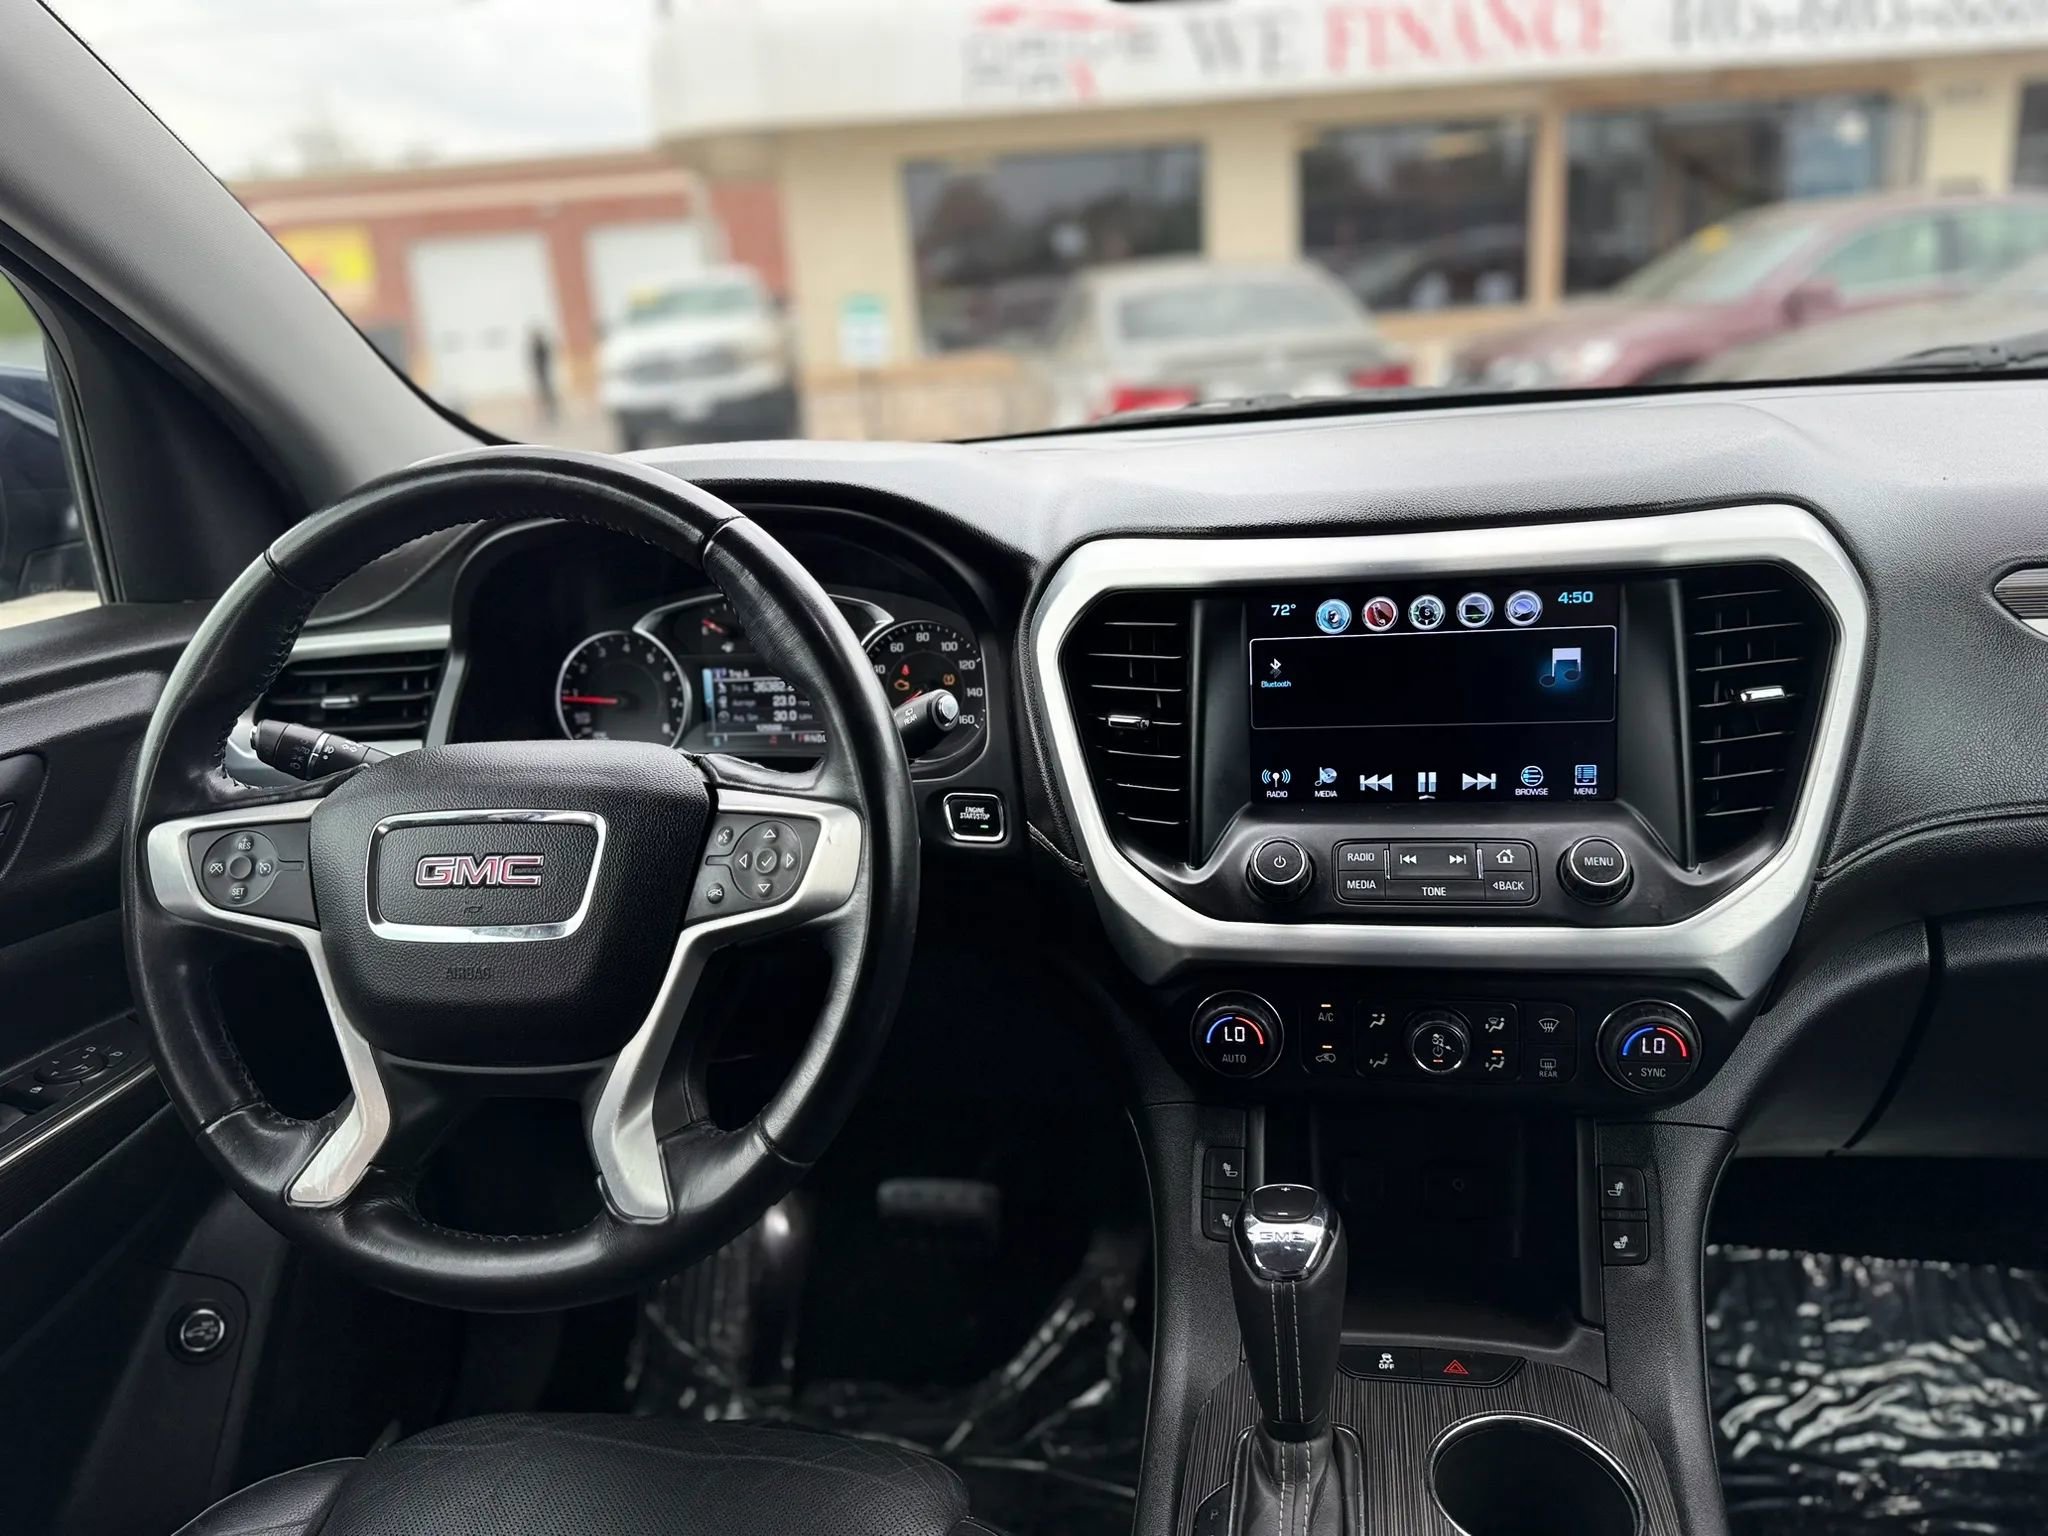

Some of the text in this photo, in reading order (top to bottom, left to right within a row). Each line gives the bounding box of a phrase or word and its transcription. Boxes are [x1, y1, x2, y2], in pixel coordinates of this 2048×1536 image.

[1324, 0, 1616, 72] FINANCE
[1557, 591, 1594, 604] 4:50
[1271, 603, 1297, 617] 72°
[915, 632, 930, 642] 80
[889, 642, 904, 653] 60
[941, 641, 958, 652] 100
[959, 660, 976, 670] 120
[1260, 680, 1292, 689] Bluetooth
[966, 687, 983, 698] 140
[903, 714, 918, 726] REAR
[959, 715, 975, 725] 160
[1266, 790, 1289, 798] RADIO
[1314, 790, 1338, 798] MEDIA
[1514, 787, 1549, 796] BROWSE
[1573, 787, 1598, 795] MENU
[238, 842, 251, 850] RES
[1346, 852, 1375, 862] RADIO
[1584, 856, 1614, 866] MENU
[416, 855, 544, 886] GMC
[1346, 880, 1376, 889] MEDIA
[1498, 881, 1525, 891] BACK
[231, 887, 245, 896] SET
[1421, 886, 1447, 896] TONE
[446, 967, 493, 980] AIRBAG
[1317, 1012, 1335, 1022] A/C
[1224, 1026, 1245, 1042] LO
[1641, 1037, 1666, 1054] LO
[1221, 1053, 1247, 1064] AUTO
[1538, 1070, 1558, 1078] REAR
[1640, 1067, 1667, 1078] SYNC
